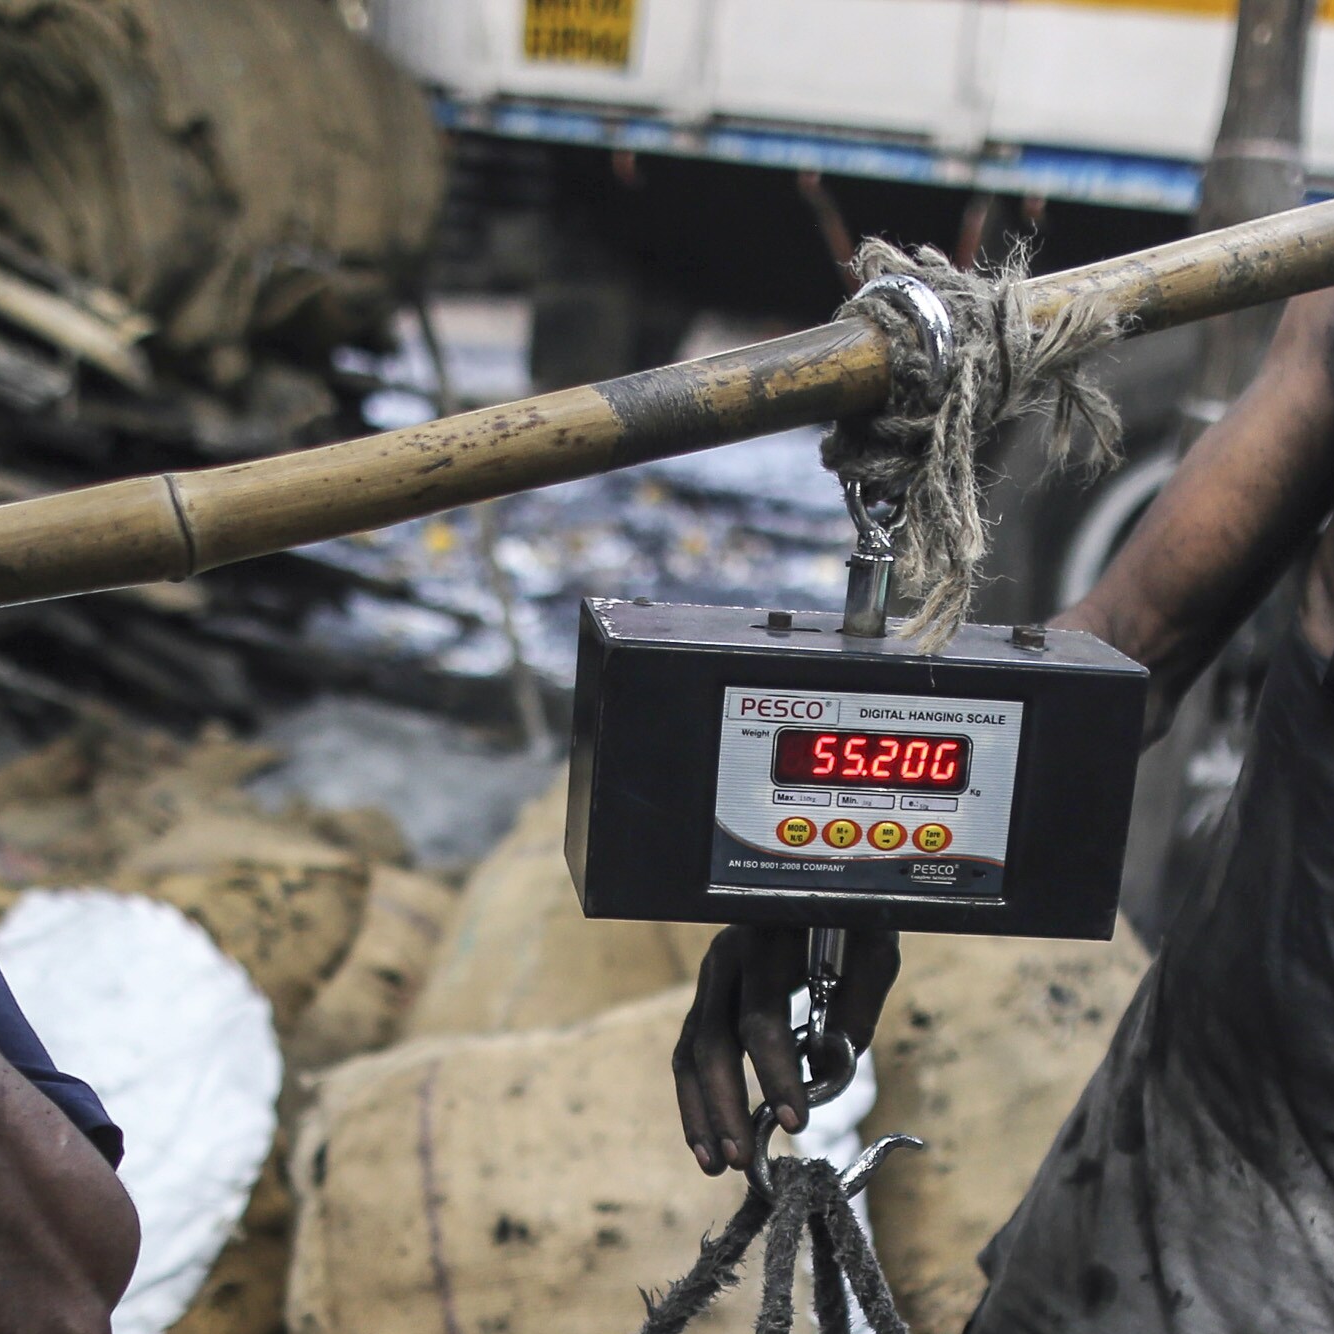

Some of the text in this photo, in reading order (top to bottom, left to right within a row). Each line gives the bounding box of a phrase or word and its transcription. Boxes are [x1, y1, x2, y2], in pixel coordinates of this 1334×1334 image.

[741, 698, 824, 720] PESCO
[860, 708, 1006, 725] DIGITAL HANGING SCALE
[741, 728, 770, 738] Weight
[777, 793, 796, 801] Max.
[970, 788, 981, 797] Kg
[842, 796, 859, 804] Min.
[788, 824, 807, 833] MODE
[925, 830, 940, 838] Tare
[729, 860, 845, 872] AN ISO 9001:2008 COMPANY
[913, 864, 954, 875] PESCO
